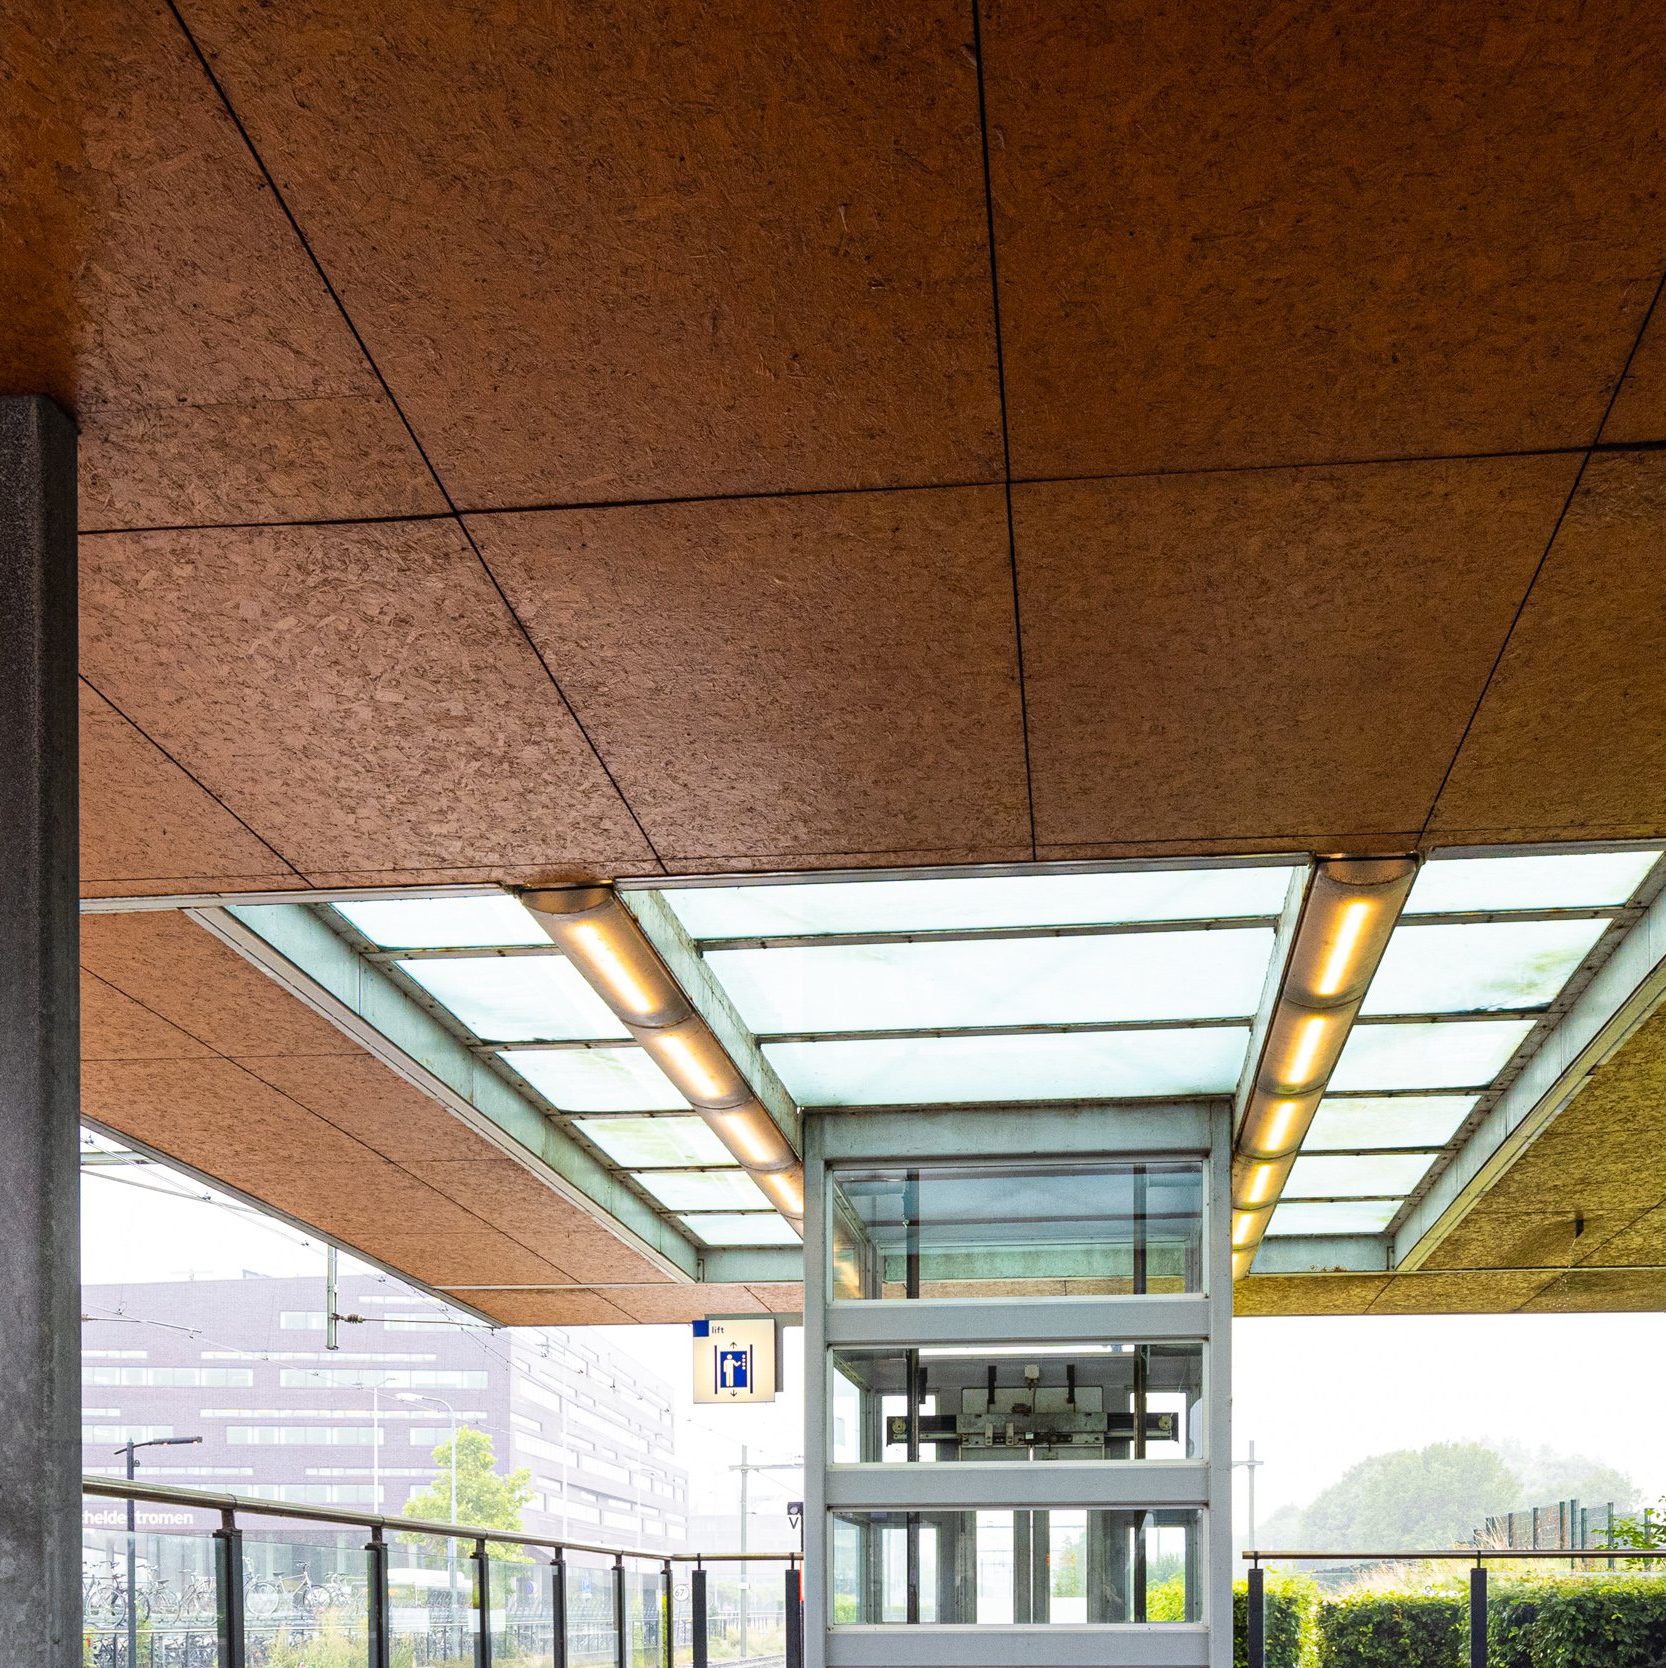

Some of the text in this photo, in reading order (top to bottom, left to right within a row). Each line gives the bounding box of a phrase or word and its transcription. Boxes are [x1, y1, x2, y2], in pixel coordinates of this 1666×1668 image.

[711, 1326, 724, 1334] lift
[82, 1510, 194, 1525] heldetromen
[788, 1516, 799, 1529] V
[674, 1588, 684, 1597] 67
